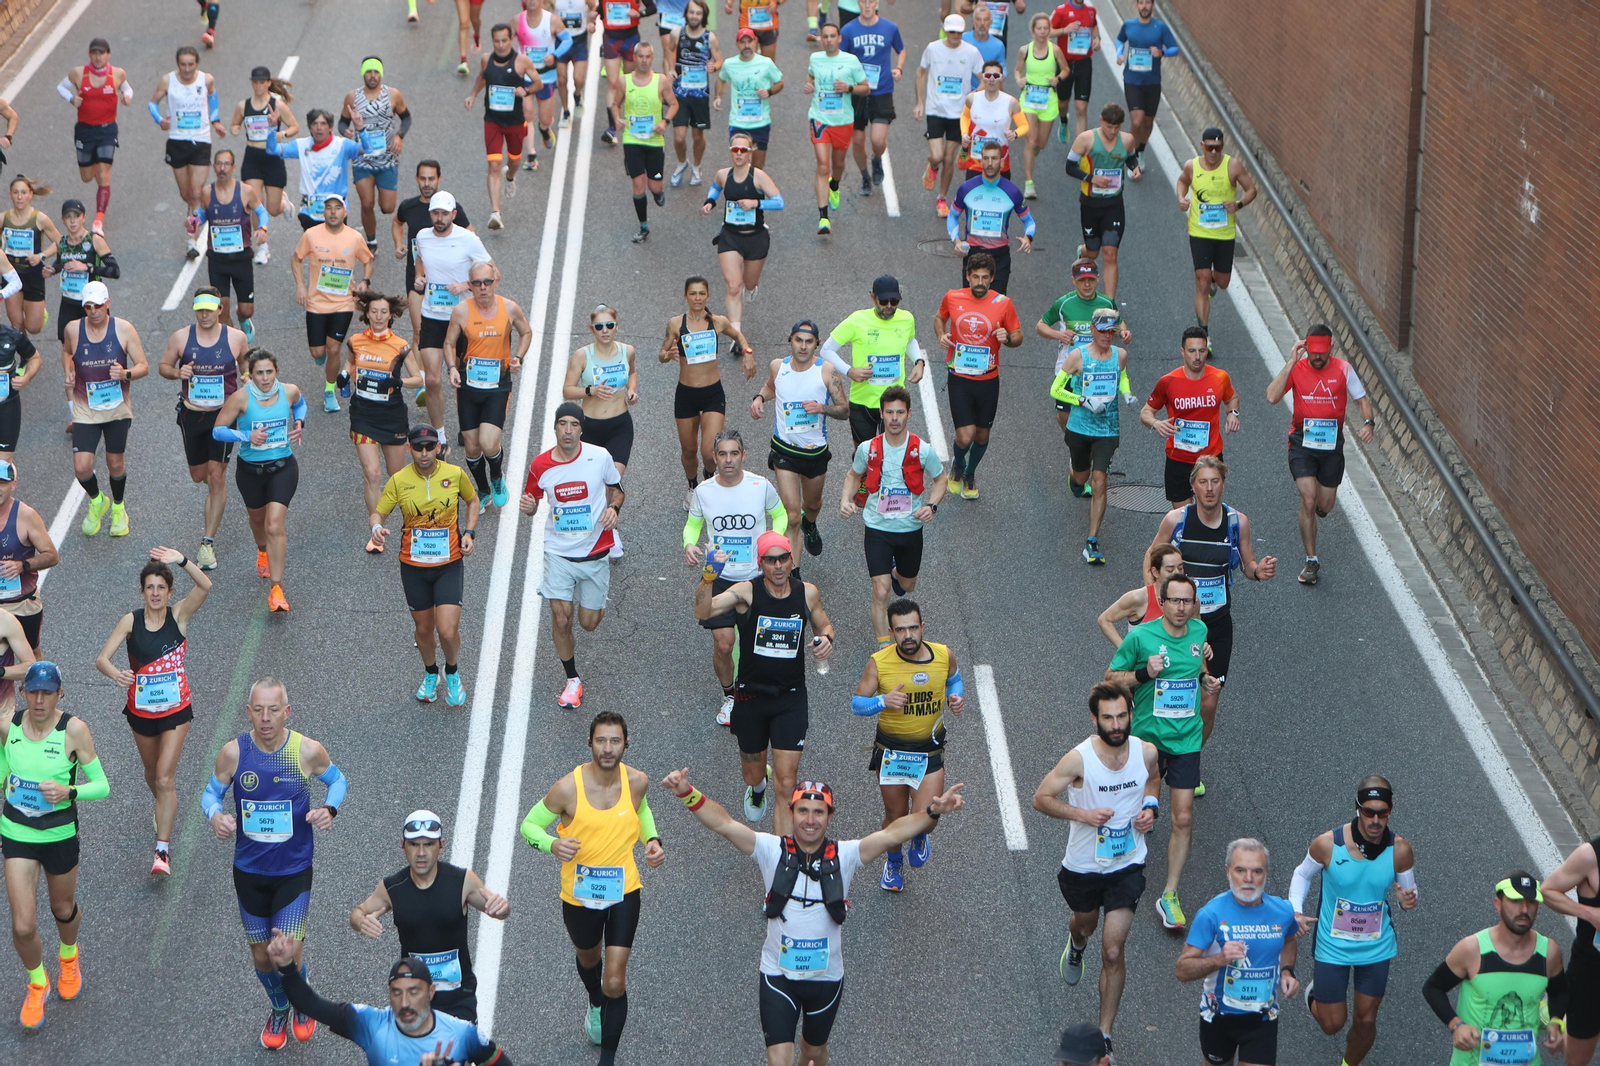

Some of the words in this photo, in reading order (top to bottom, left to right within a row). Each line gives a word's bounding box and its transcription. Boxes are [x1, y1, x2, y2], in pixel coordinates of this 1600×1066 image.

[853, 34, 885, 48] DUKE
[694, 332, 711, 340] ZURICH
[605, 365, 623, 373] ZURICH
[369, 372, 387, 380] ZURICH
[98, 380, 115, 388] ZURICH
[1174, 395, 1216, 411] CORRALES
[1186, 423, 1206, 431] ZURICH
[565, 507, 586, 515] ZURICH
[1202, 579, 1222, 587] ZURICH
[774, 621, 798, 629] ZURICH
[1163, 656, 1170, 668] 3
[149, 675, 173, 685] ZURICH
[150, 690, 164, 698] 6284
[903, 705, 915, 716] DA
[899, 755, 922, 763] ZURICH
[1109, 784, 1123, 792] REST
[1353, 903, 1379, 912] ZURICH
[1231, 924, 1270, 933] EUSKADI
[1232, 932, 1257, 940] BASQUE
[797, 941, 823, 949] ZURICH
[426, 954, 453, 965] ZURICH
[1244, 970, 1270, 979] ZURICH
[1241, 985, 1257, 993] 5111
[1501, 1032, 1529, 1041] ZURICH
[1499, 1048, 1517, 1056] 4277
